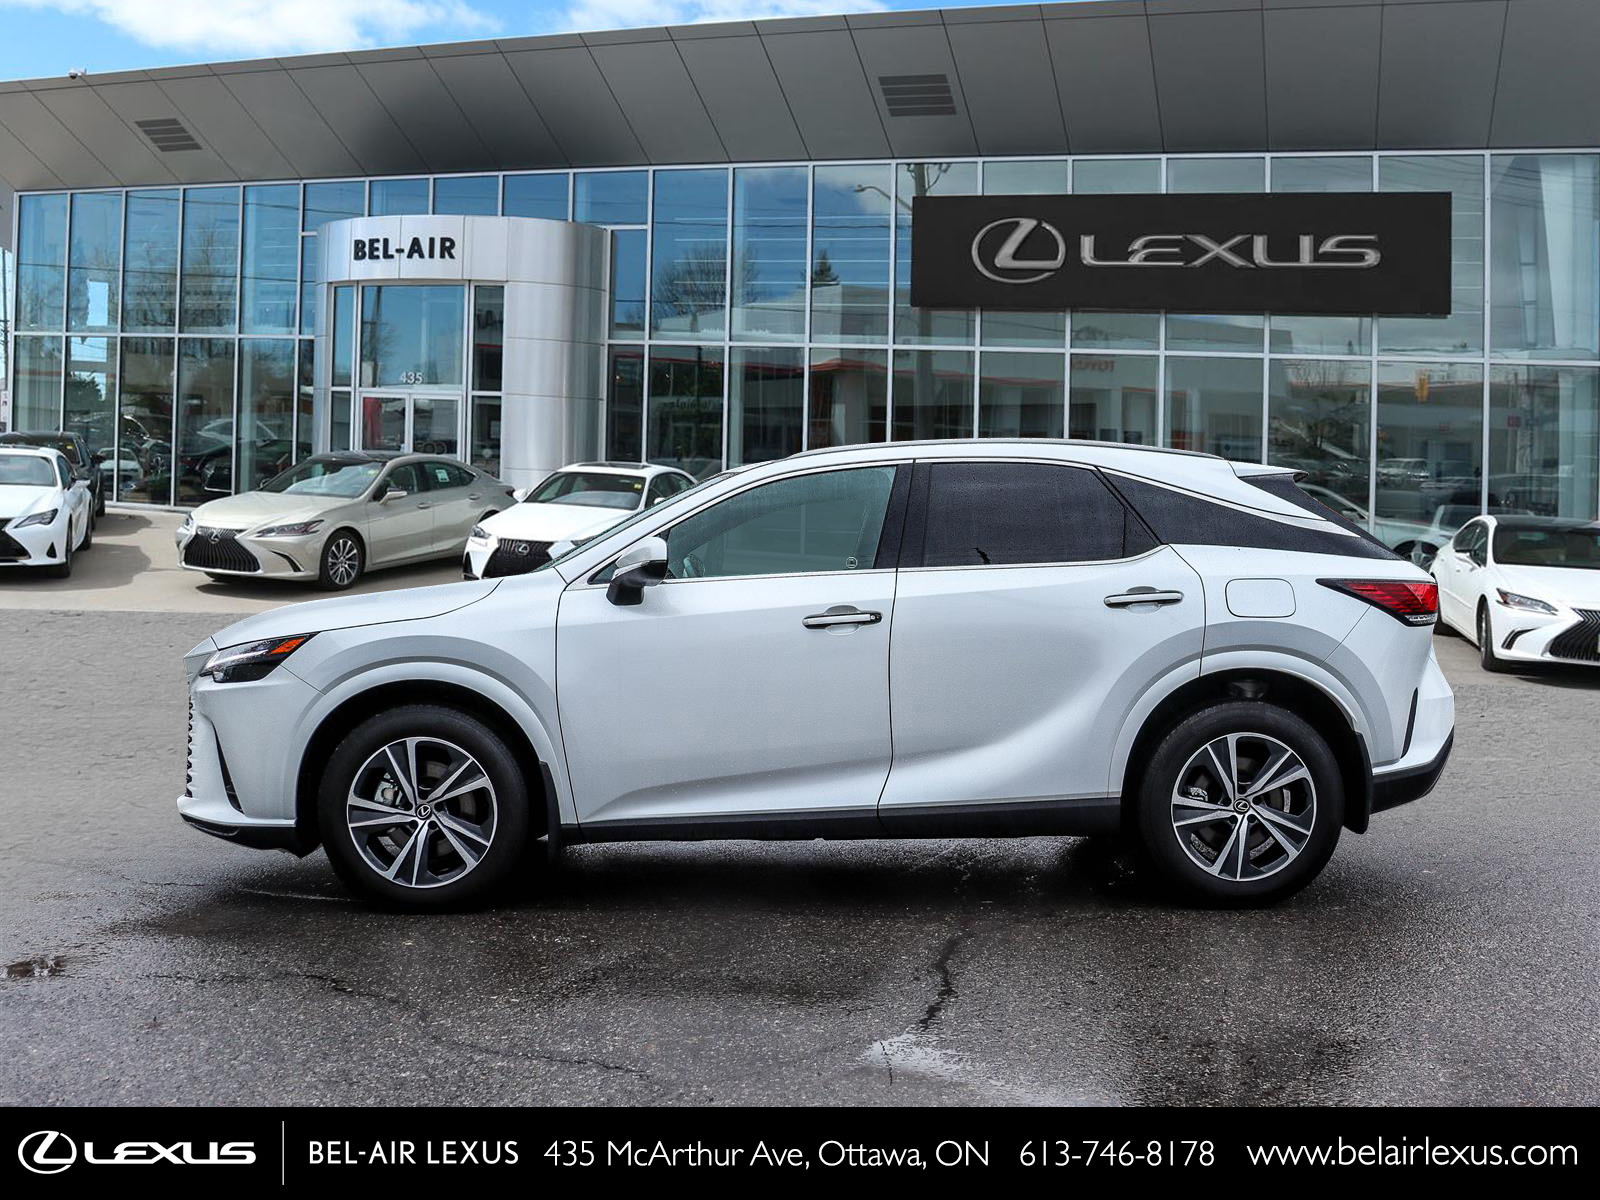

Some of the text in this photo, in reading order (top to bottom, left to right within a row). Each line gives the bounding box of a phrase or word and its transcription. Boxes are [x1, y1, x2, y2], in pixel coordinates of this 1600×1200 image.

[353, 237, 456, 261] BEL-AIR
[1079, 234, 1381, 269] LEXUS
[400, 372, 424, 384] 435
